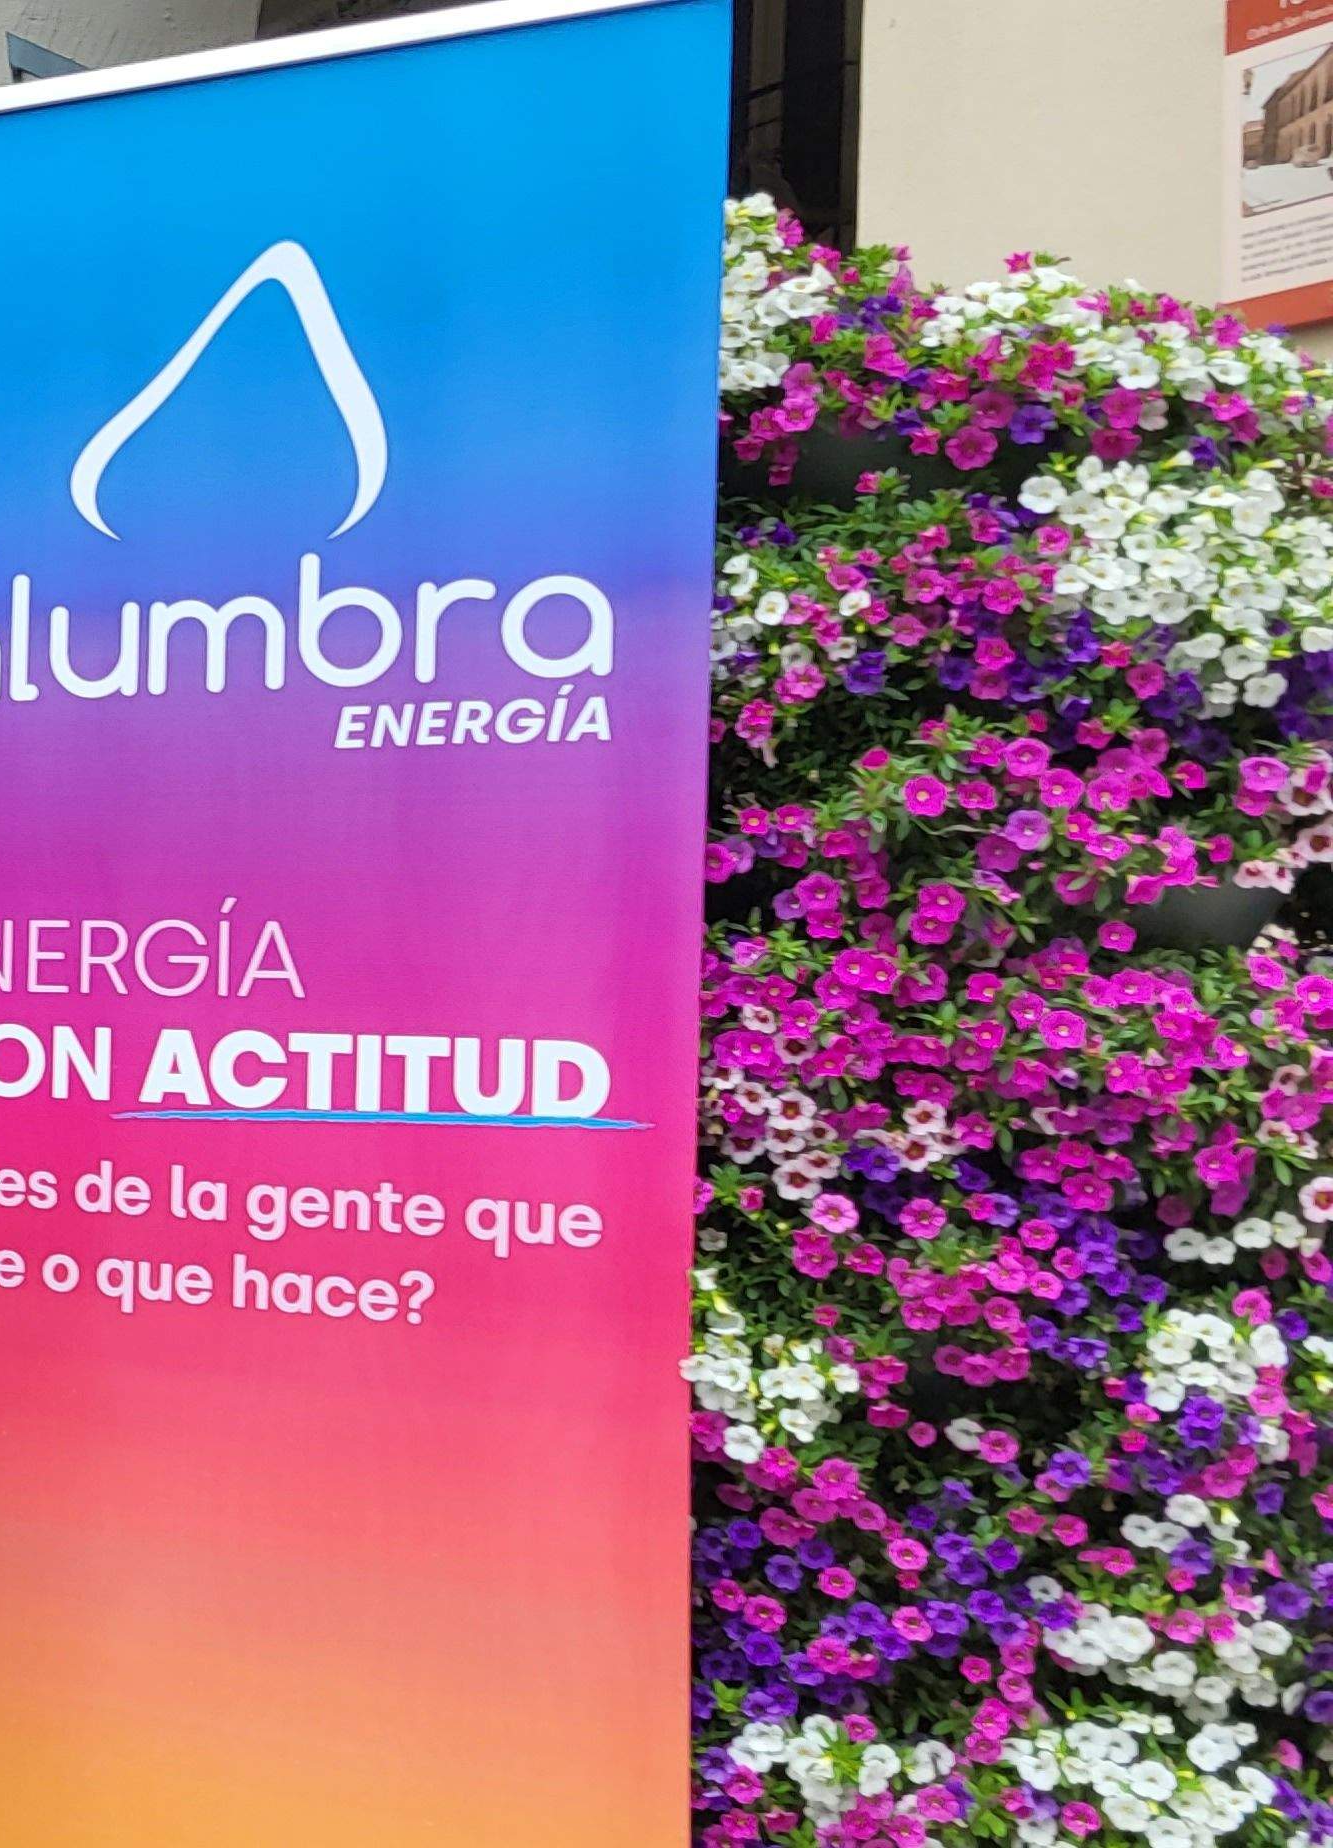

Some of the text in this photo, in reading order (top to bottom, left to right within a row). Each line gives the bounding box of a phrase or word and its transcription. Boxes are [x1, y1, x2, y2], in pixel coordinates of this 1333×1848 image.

[334, 685, 612, 749] ENERGÍA
[139, 1028, 611, 1119] ACTITUD
[75, 1160, 151, 1216] de
[170, 1165, 227, 1222] la
[246, 1181, 445, 1241] gente
[465, 1198, 604, 1259] que
[42, 1254, 80, 1293] o
[96, 1258, 213, 1313] que
[233, 1254, 435, 1325] hace?
